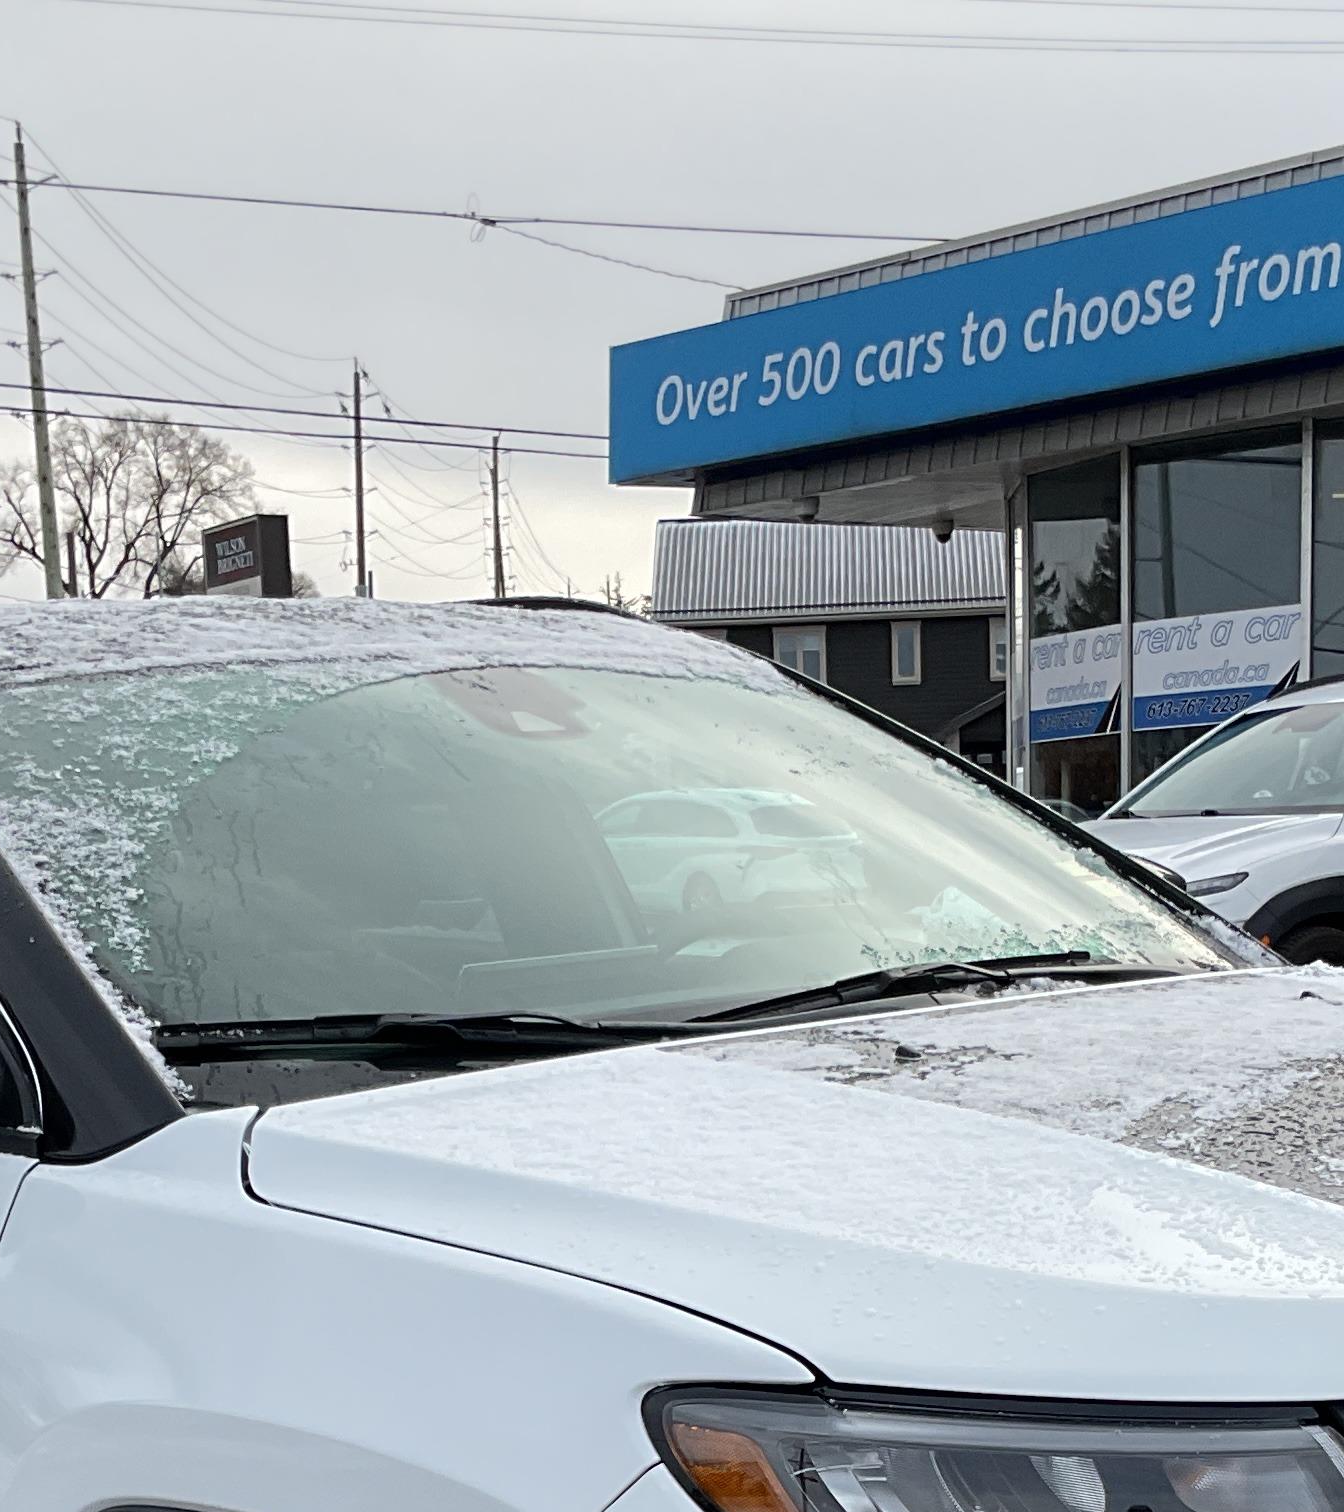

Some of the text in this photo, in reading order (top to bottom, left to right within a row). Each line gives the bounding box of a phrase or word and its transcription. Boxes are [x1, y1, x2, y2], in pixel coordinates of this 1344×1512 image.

[655, 368, 747, 427] Over
[757, 339, 841, 408] 500
[854, 324, 945, 388] cars
[960, 309, 1007, 365] to
[1022, 272, 1193, 354] choose
[1134, 612, 1302, 655] rent a car
[1073, 638, 1086, 664] a
[1163, 659, 1270, 690] canada.ca
[1147, 693, 1253, 720] 613-767-2237
